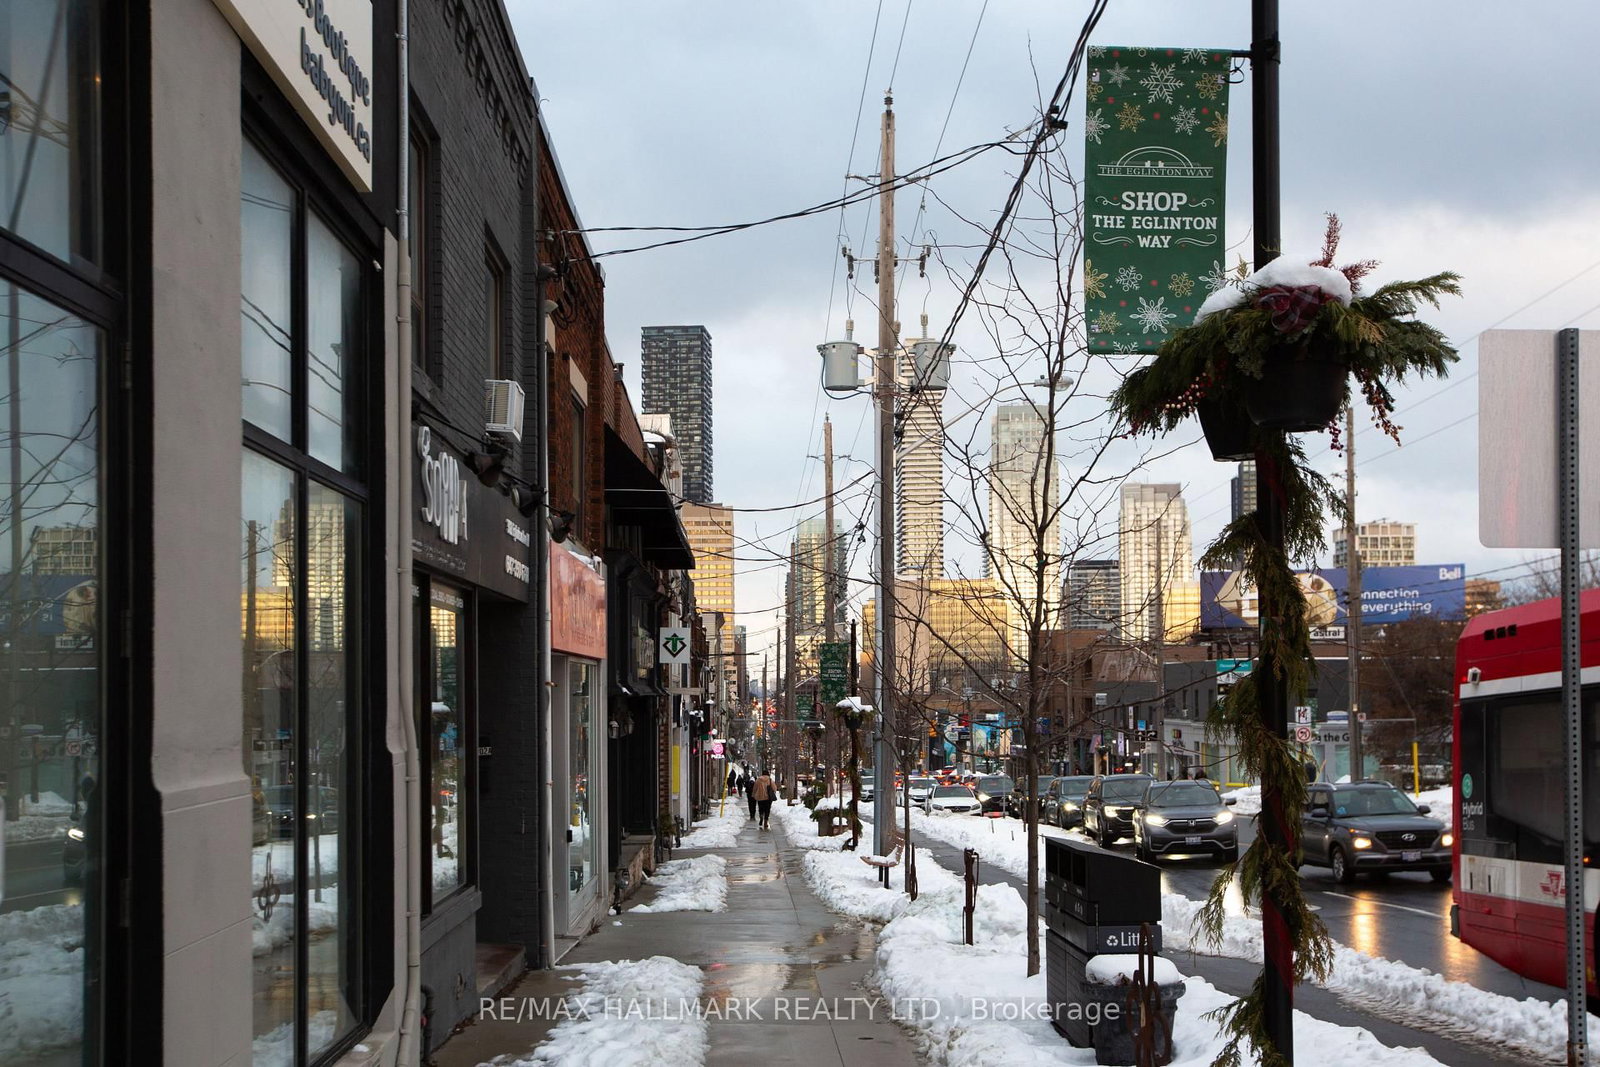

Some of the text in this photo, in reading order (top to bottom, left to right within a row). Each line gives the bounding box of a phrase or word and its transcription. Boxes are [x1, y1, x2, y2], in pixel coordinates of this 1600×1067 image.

[1100, 167, 1212, 177] THE EGLINTON WAY
[1121, 191, 1188, 211] SHOP
[1092, 214, 1218, 230] THE EGLINTON
[1136, 235, 1172, 248] WAY
[1439, 567, 1461, 580] Bell
[1361, 600, 1432, 615] everything
[1313, 628, 1341, 637] astral
[1323, 733, 1340, 742] the
[1462, 802, 1483, 818] Hybrid
[1463, 817, 1475, 831] Bus
[1121, 931, 1155, 947] Litt
